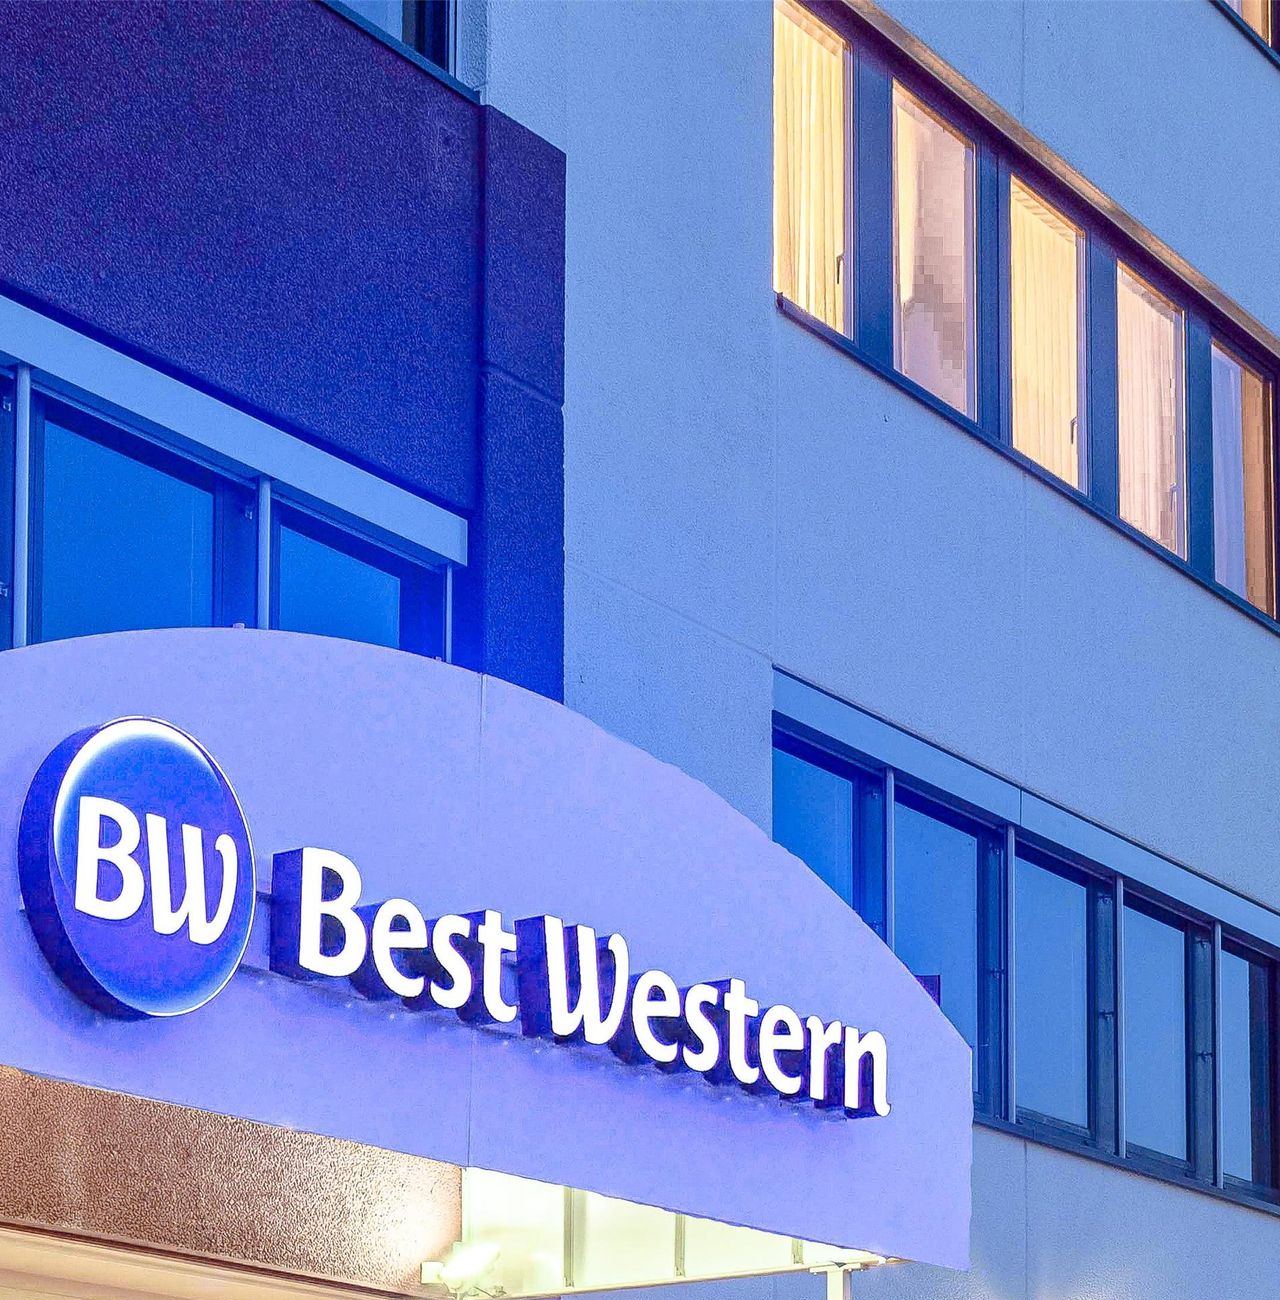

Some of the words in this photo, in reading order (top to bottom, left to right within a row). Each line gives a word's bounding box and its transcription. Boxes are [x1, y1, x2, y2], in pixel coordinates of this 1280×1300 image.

[74, 795, 239, 946] BW
[298, 846, 518, 1023] Best
[543, 914, 893, 1118] Western
